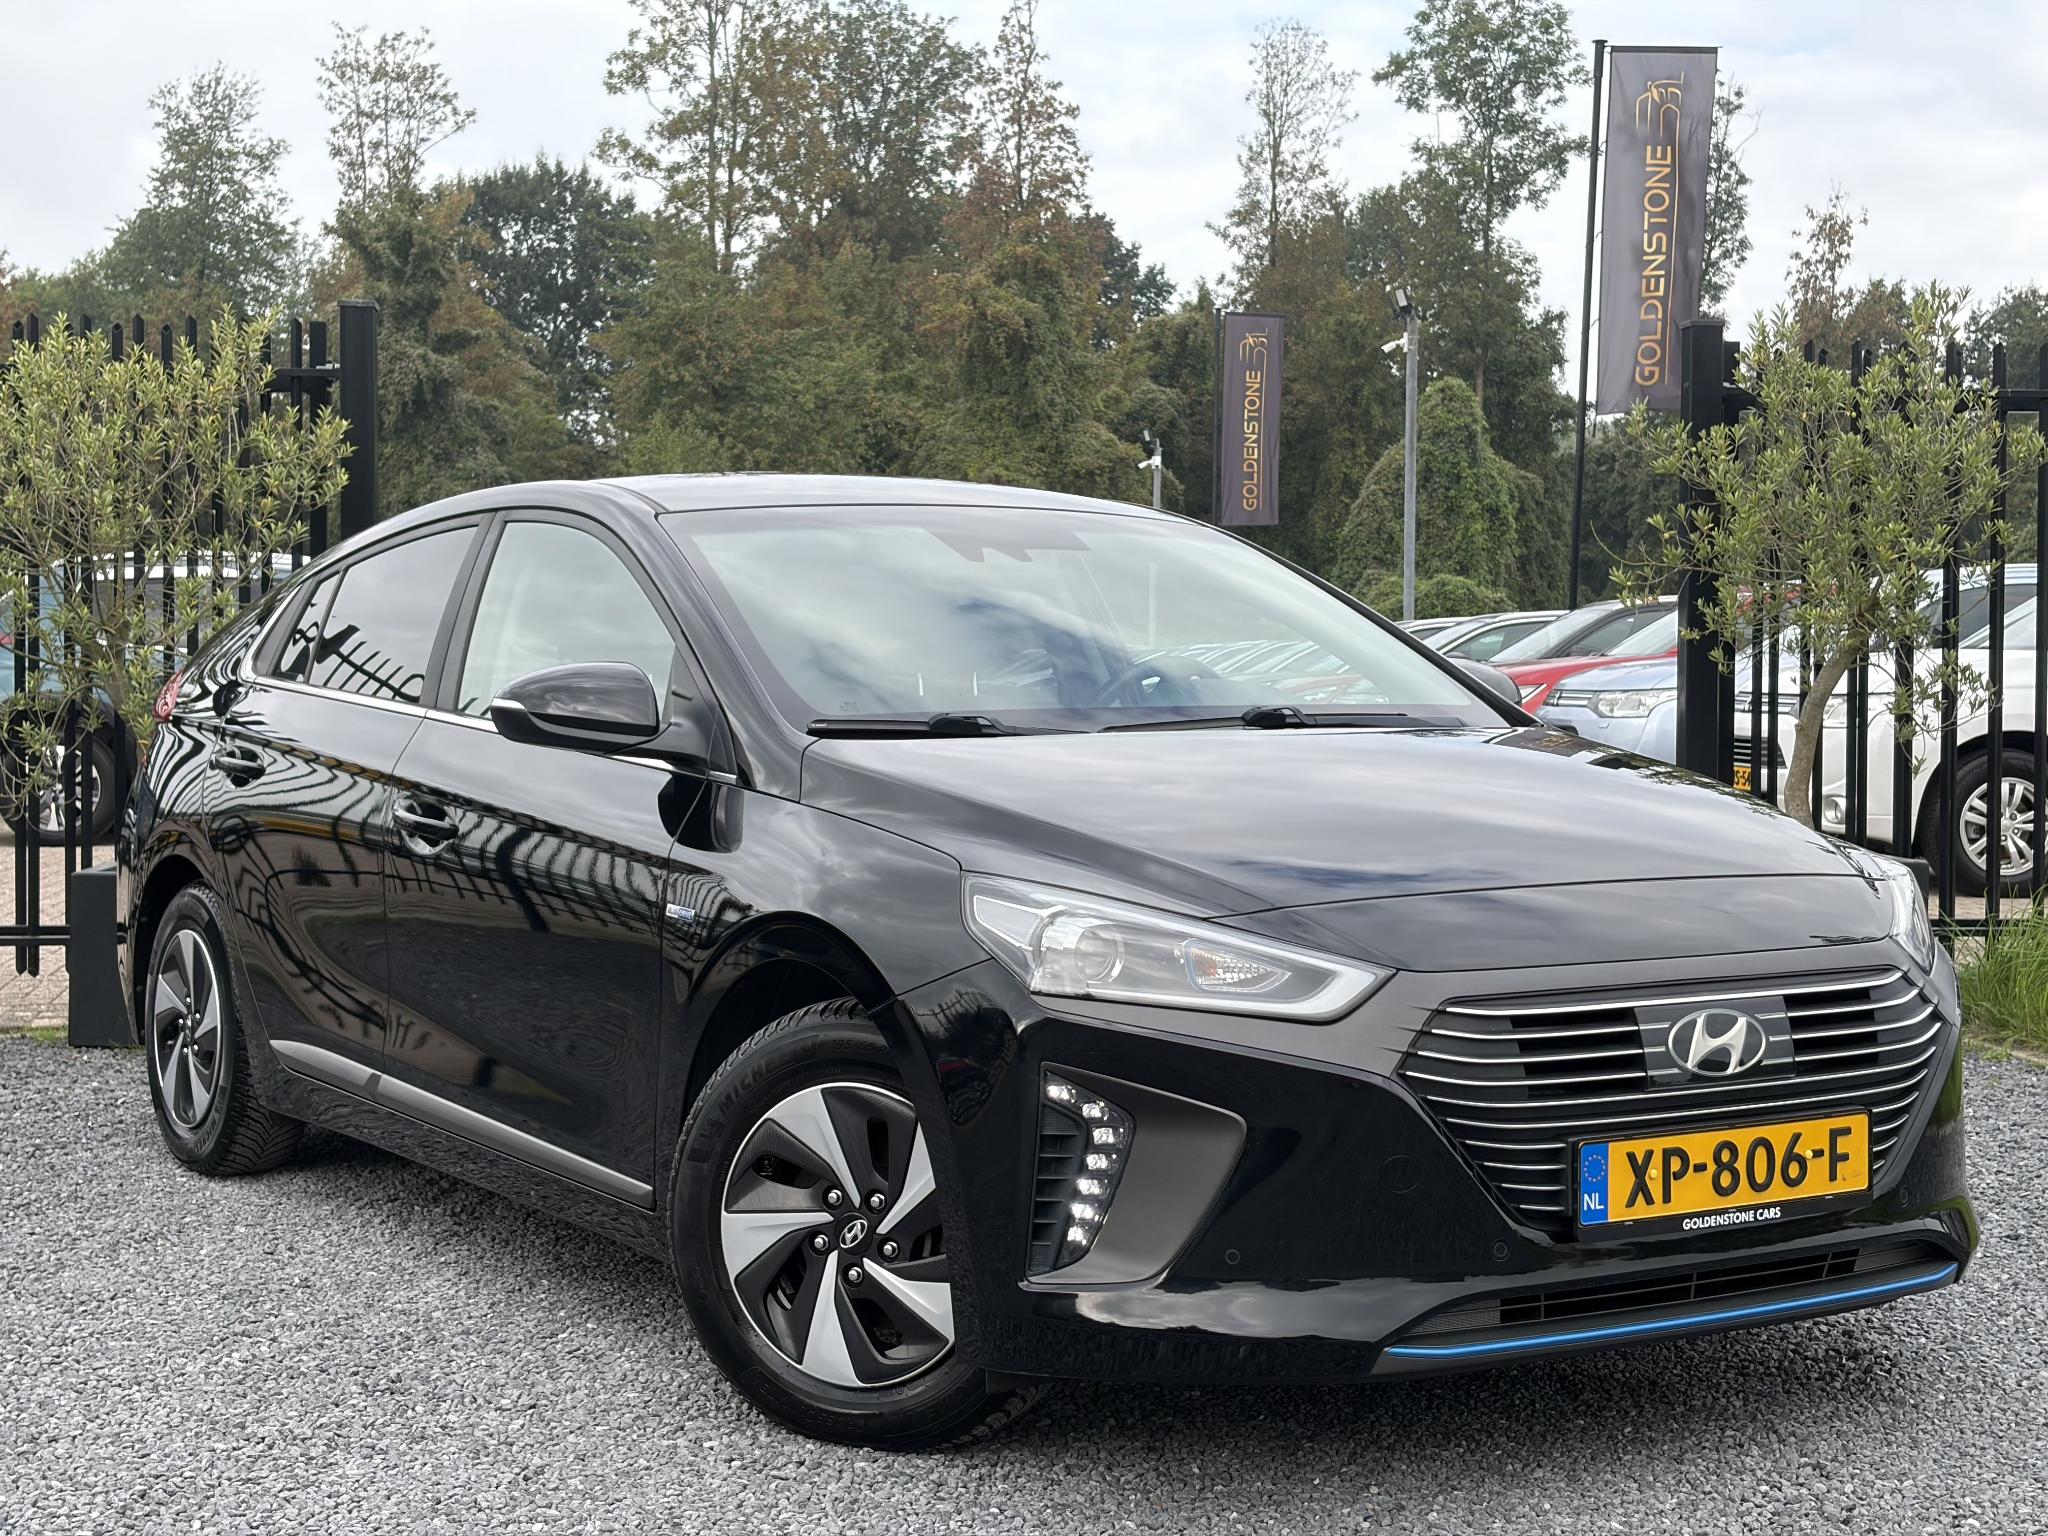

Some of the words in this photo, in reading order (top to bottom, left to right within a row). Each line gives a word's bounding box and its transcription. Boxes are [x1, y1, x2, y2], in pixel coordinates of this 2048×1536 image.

[1635, 145, 1672, 385] GOLDENSTONE
[1243, 370, 1261, 511] GOLDENSTONE
[718, 1038, 824, 1117] MICHEIN
[1583, 1192, 1604, 1211] NL
[1625, 1127, 1852, 1207] XP-806-F
[1682, 1209, 1755, 1230] GOLDENSTONE
[1756, 1206, 1781, 1220] CARS
